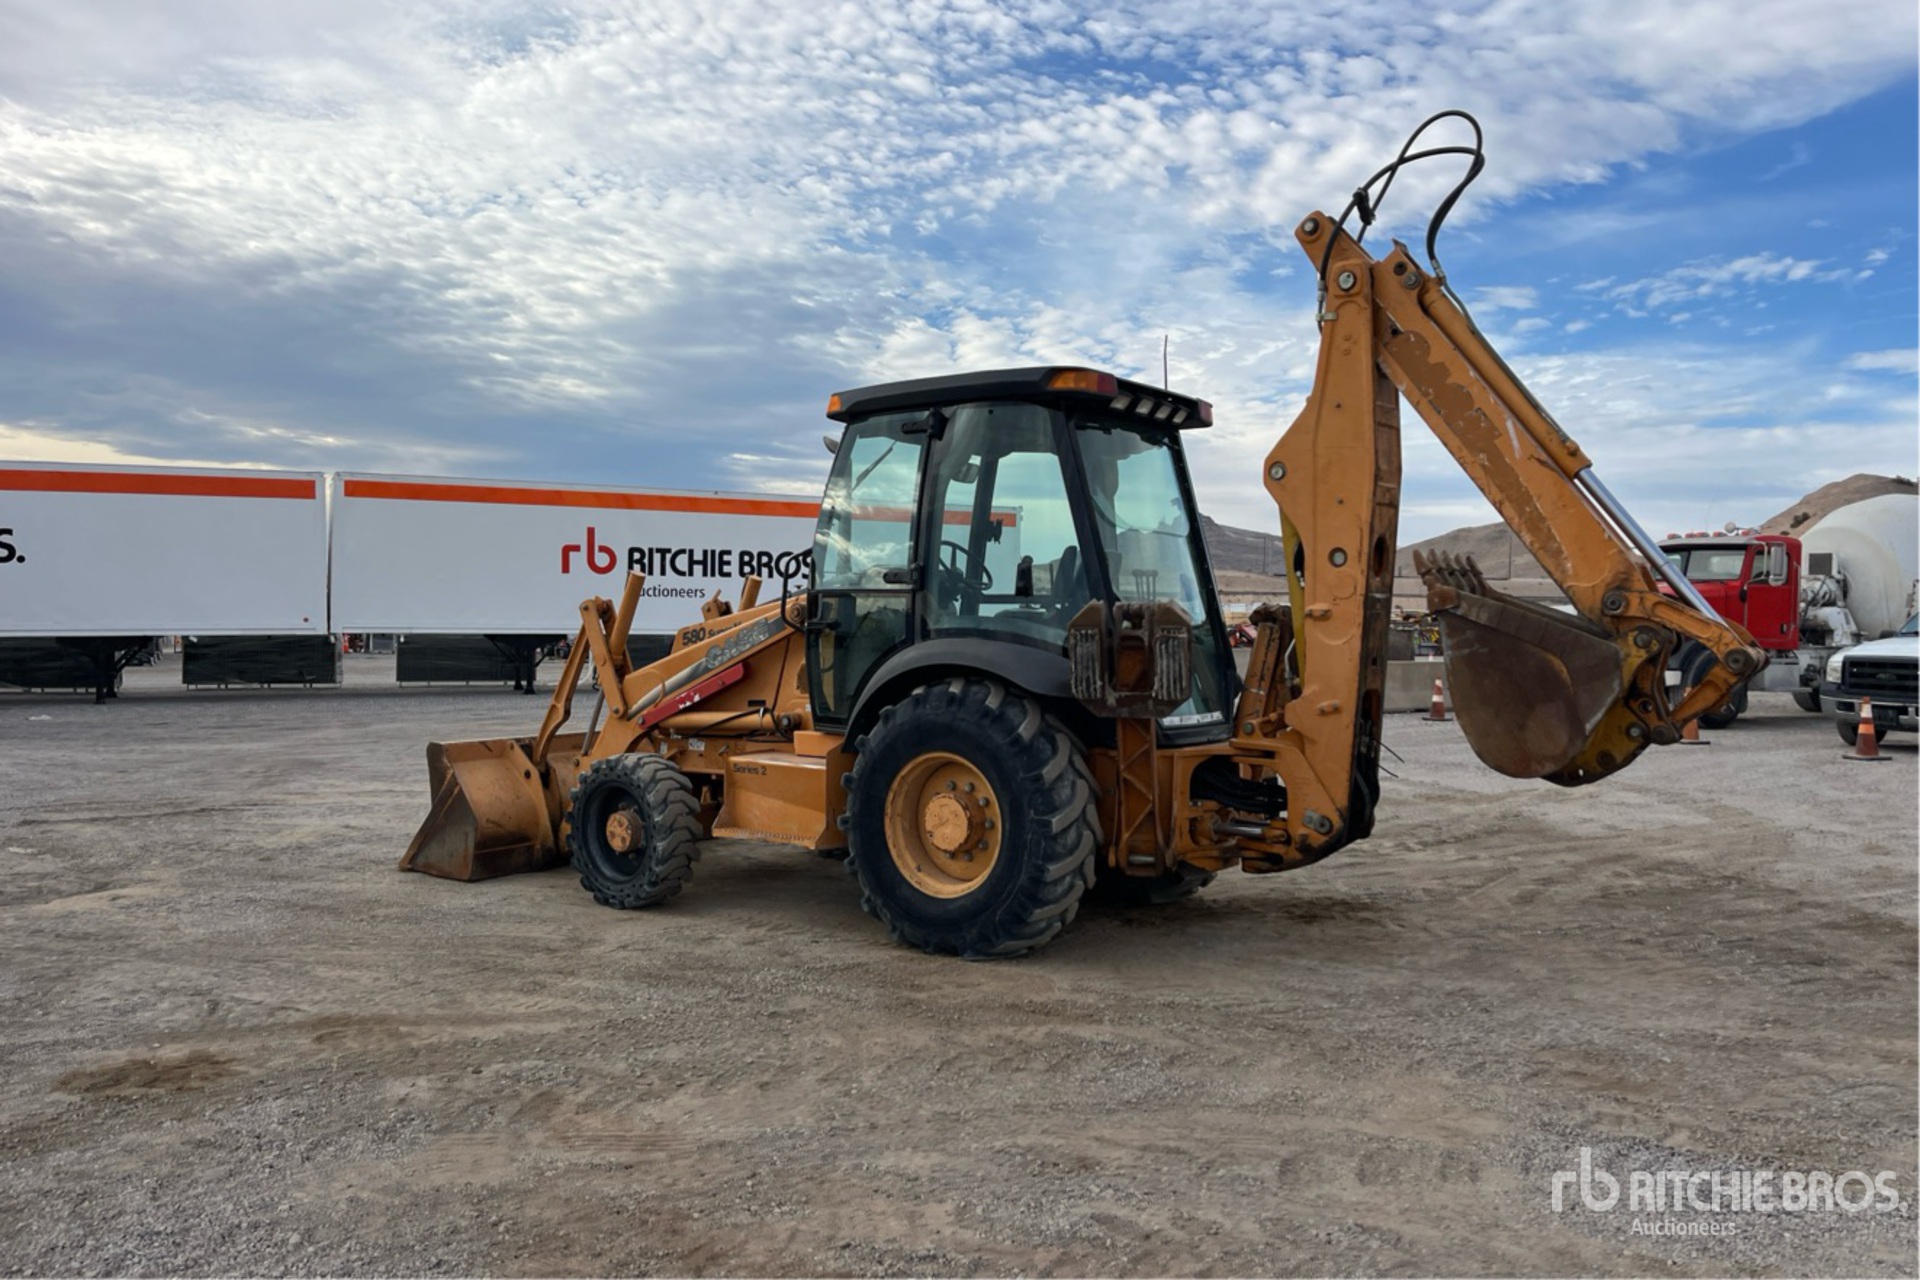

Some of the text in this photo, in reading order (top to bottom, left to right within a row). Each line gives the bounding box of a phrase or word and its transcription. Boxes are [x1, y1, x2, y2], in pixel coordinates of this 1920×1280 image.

[561, 526, 617, 574] rb
[627, 547, 732, 577] RITCHIE
[639, 585, 705, 599] uctioneers
[682, 627, 706, 646] 580
[733, 763, 768, 775] Series 2
